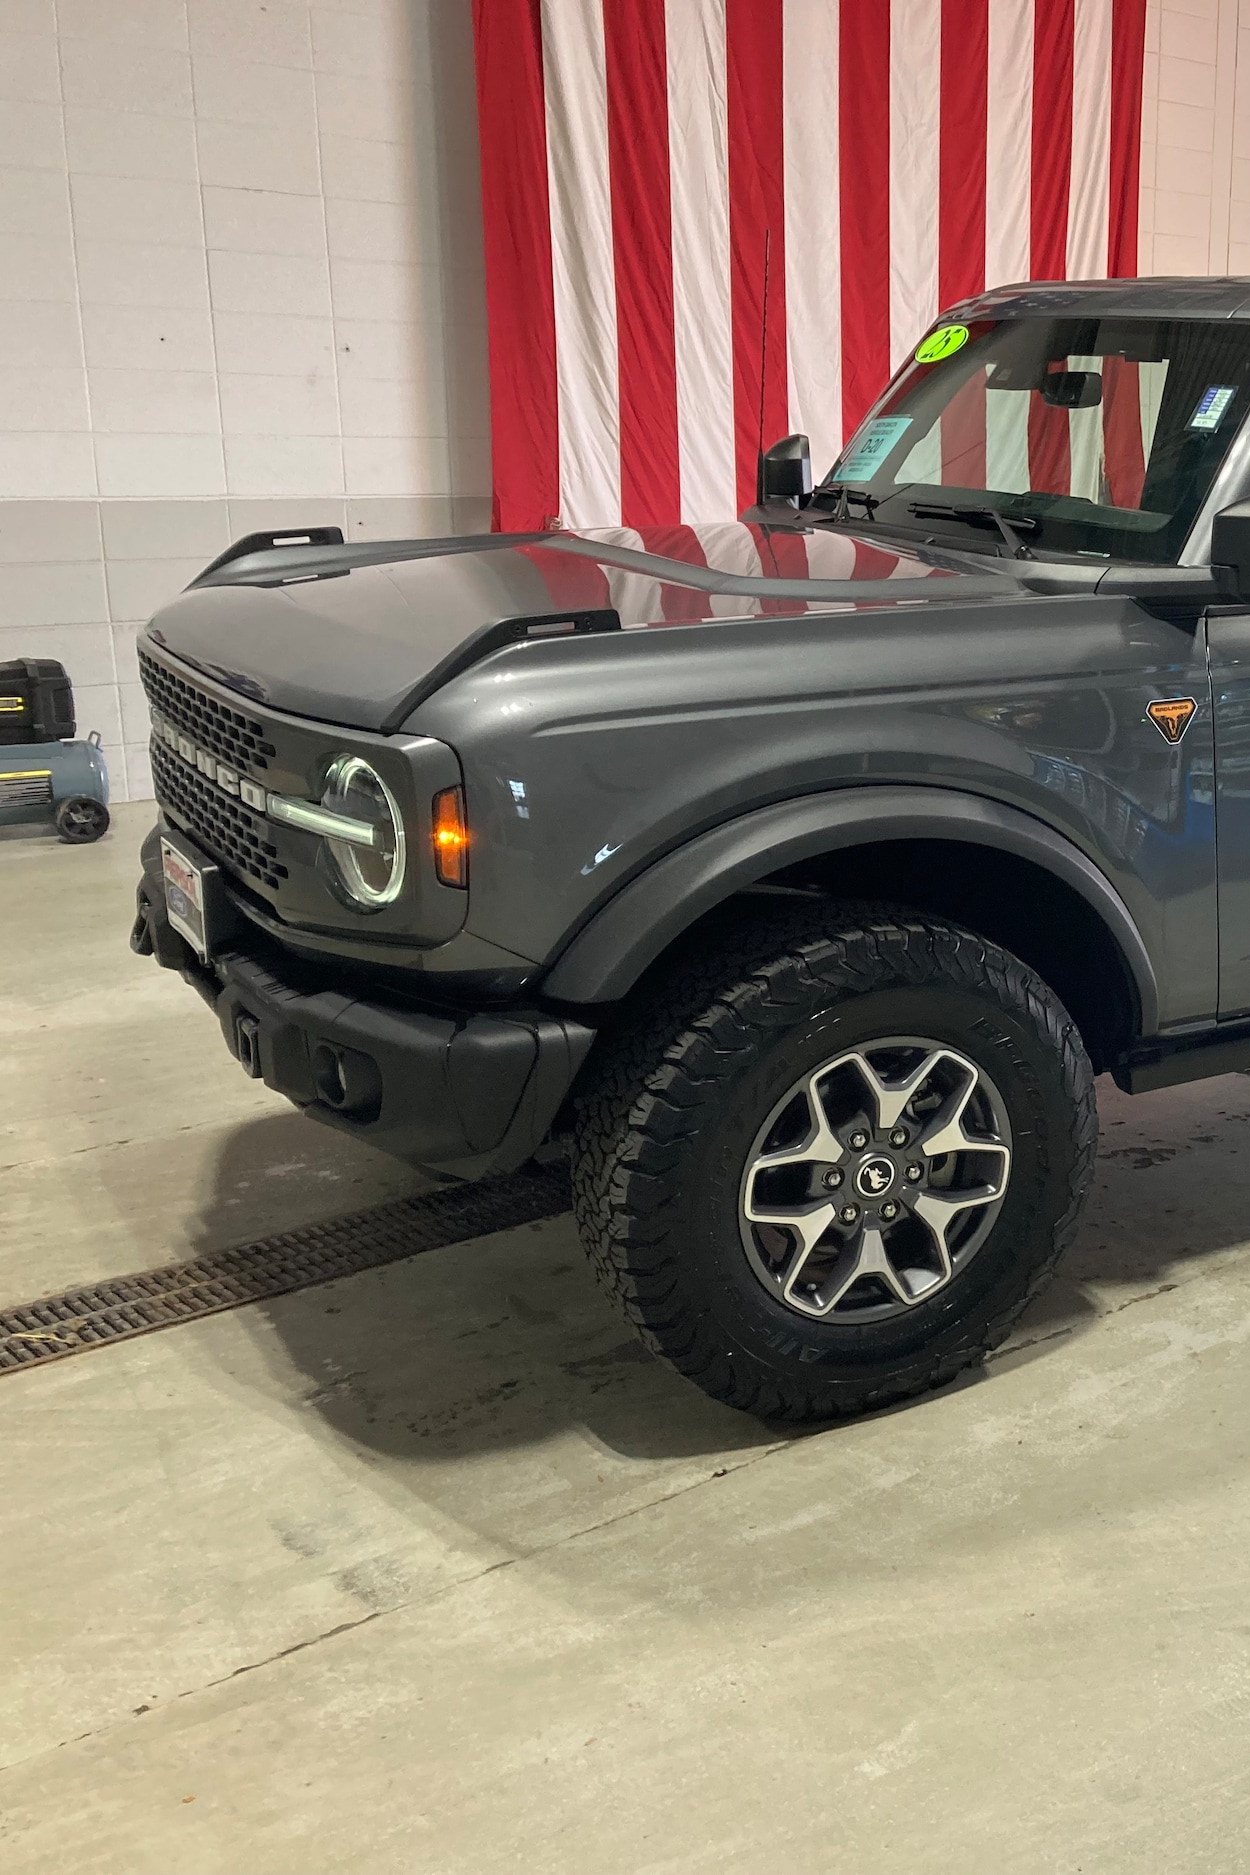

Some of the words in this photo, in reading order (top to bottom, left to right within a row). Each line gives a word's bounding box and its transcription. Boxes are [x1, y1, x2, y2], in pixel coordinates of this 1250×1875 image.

[919, 328, 963, 359] 25
[1155, 704, 1188, 712] BADLANDS
[152, 708, 266, 812] BRONCO
